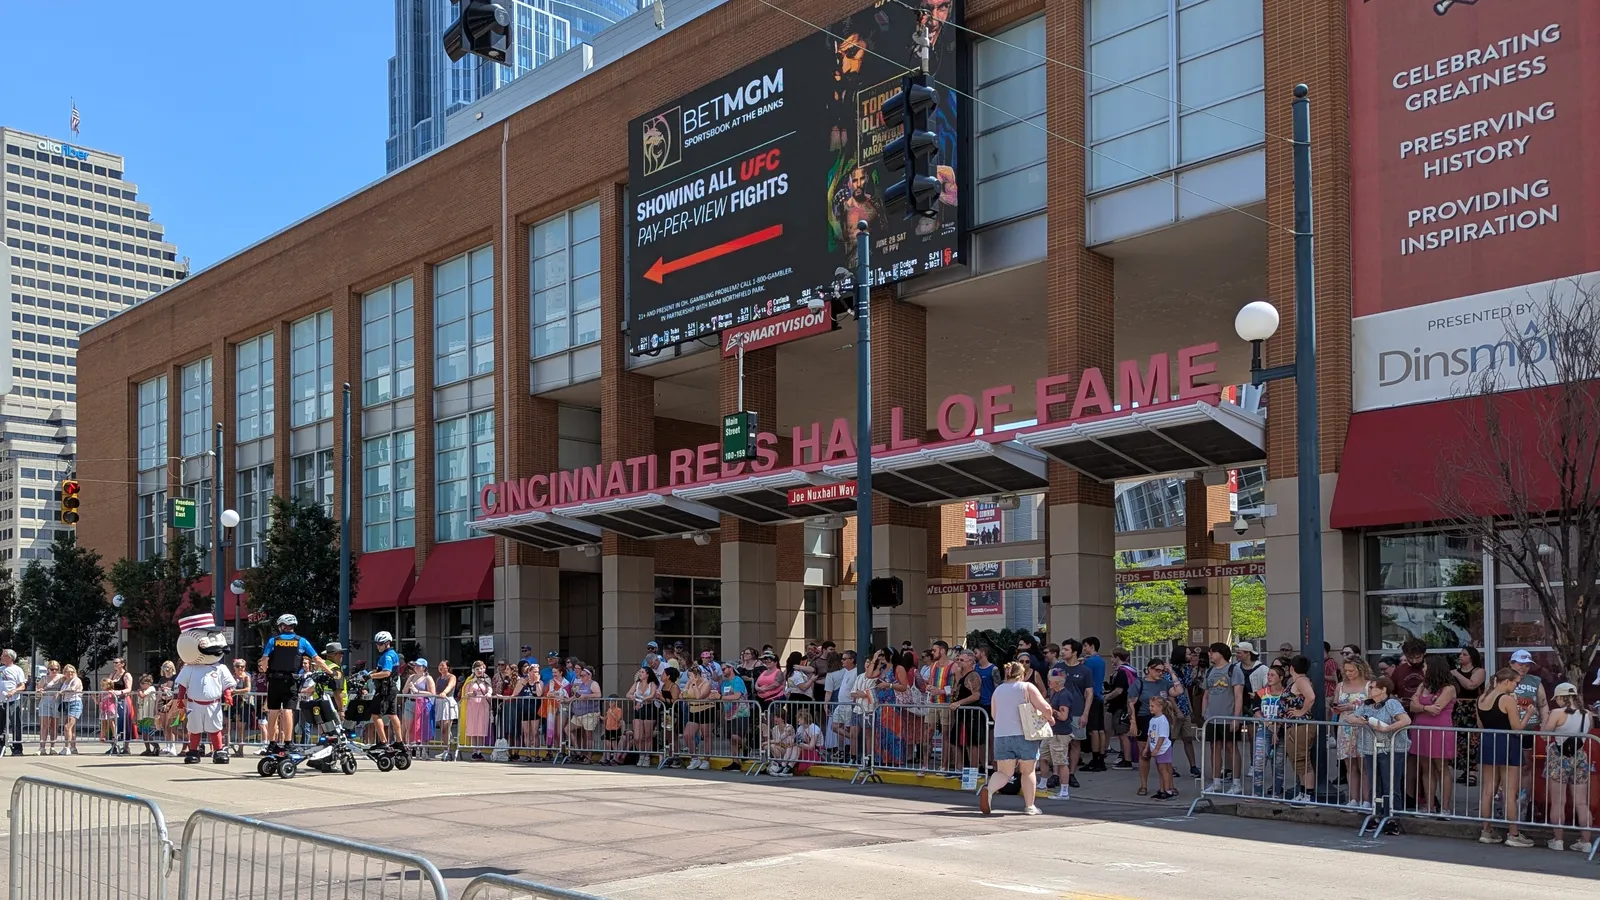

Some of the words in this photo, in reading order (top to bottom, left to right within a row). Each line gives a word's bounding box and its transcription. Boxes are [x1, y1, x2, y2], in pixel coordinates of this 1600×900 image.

[1392, 23, 1562, 89] CELEBRATING
[684, 67, 784, 134] BETMGM
[1405, 55, 1547, 112] GREATNESS
[684, 121, 730, 148] SPORTSBOOK
[731, 117, 741, 128] AT
[742, 110, 757, 124] THE
[757, 98, 784, 119] BANKS
[1399, 101, 1556, 159] PRESERVING
[37, 139, 90, 161] altafiber
[1423, 134, 1531, 179] HISTORY
[636, 178, 705, 222] SHOWING
[708, 166, 737, 195] ALL
[740, 148, 781, 181] UFC
[1407, 179, 1550, 228] PROVIDING
[637, 195, 728, 247] PAY-PER-VIEW
[730, 172, 789, 213] FIGHTS
[1400, 204, 1559, 256] INSPIRATION
[896, 231, 907, 242] SAT
[646, 309, 656, 317] AND
[656, 303, 675, 315] PRESENT
[689, 291, 714, 304] GAMBLING
[714, 283, 740, 296] PROBLEM?
[740, 280, 752, 288] CALL
[752, 267, 794, 284] 1-800-GAMBLER.
[666, 305, 695, 320] PARTNERSHIP
[695, 302, 708, 311] WITH
[708, 298, 722, 307] MGM
[722, 288, 752, 304] NORTHFIELD
[743, 310, 825, 344] SMARTVISION
[1428, 306, 1512, 331] PRESENTED
[1516, 301, 1534, 315] BY
[480, 453, 658, 518] CINCINNATI
[792, 406, 921, 467] HAL
[936, 384, 1016, 440] OF
[1035, 341, 1220, 426] FAME
[725, 417, 739, 427] Main
[725, 426, 741, 437] Street
[791, 491, 805, 503] Joe
[807, 485, 837, 501] Nuxhall
[838, 484, 855, 497] Way
[926, 585, 964, 595] WELCOME
[966, 584, 977, 592] TO
[980, 583, 996, 591] THE
[998, 580, 1023, 590] HOME
[1025, 580, 1036, 588] OF
[1039, 579, 1051, 587] TH
[1115, 573, 1140, 583] REDS
[1153, 566, 1212, 580] BASEBALL'S
[1214, 565, 1246, 577] FIRST
[1249, 564, 1265, 574] PR
